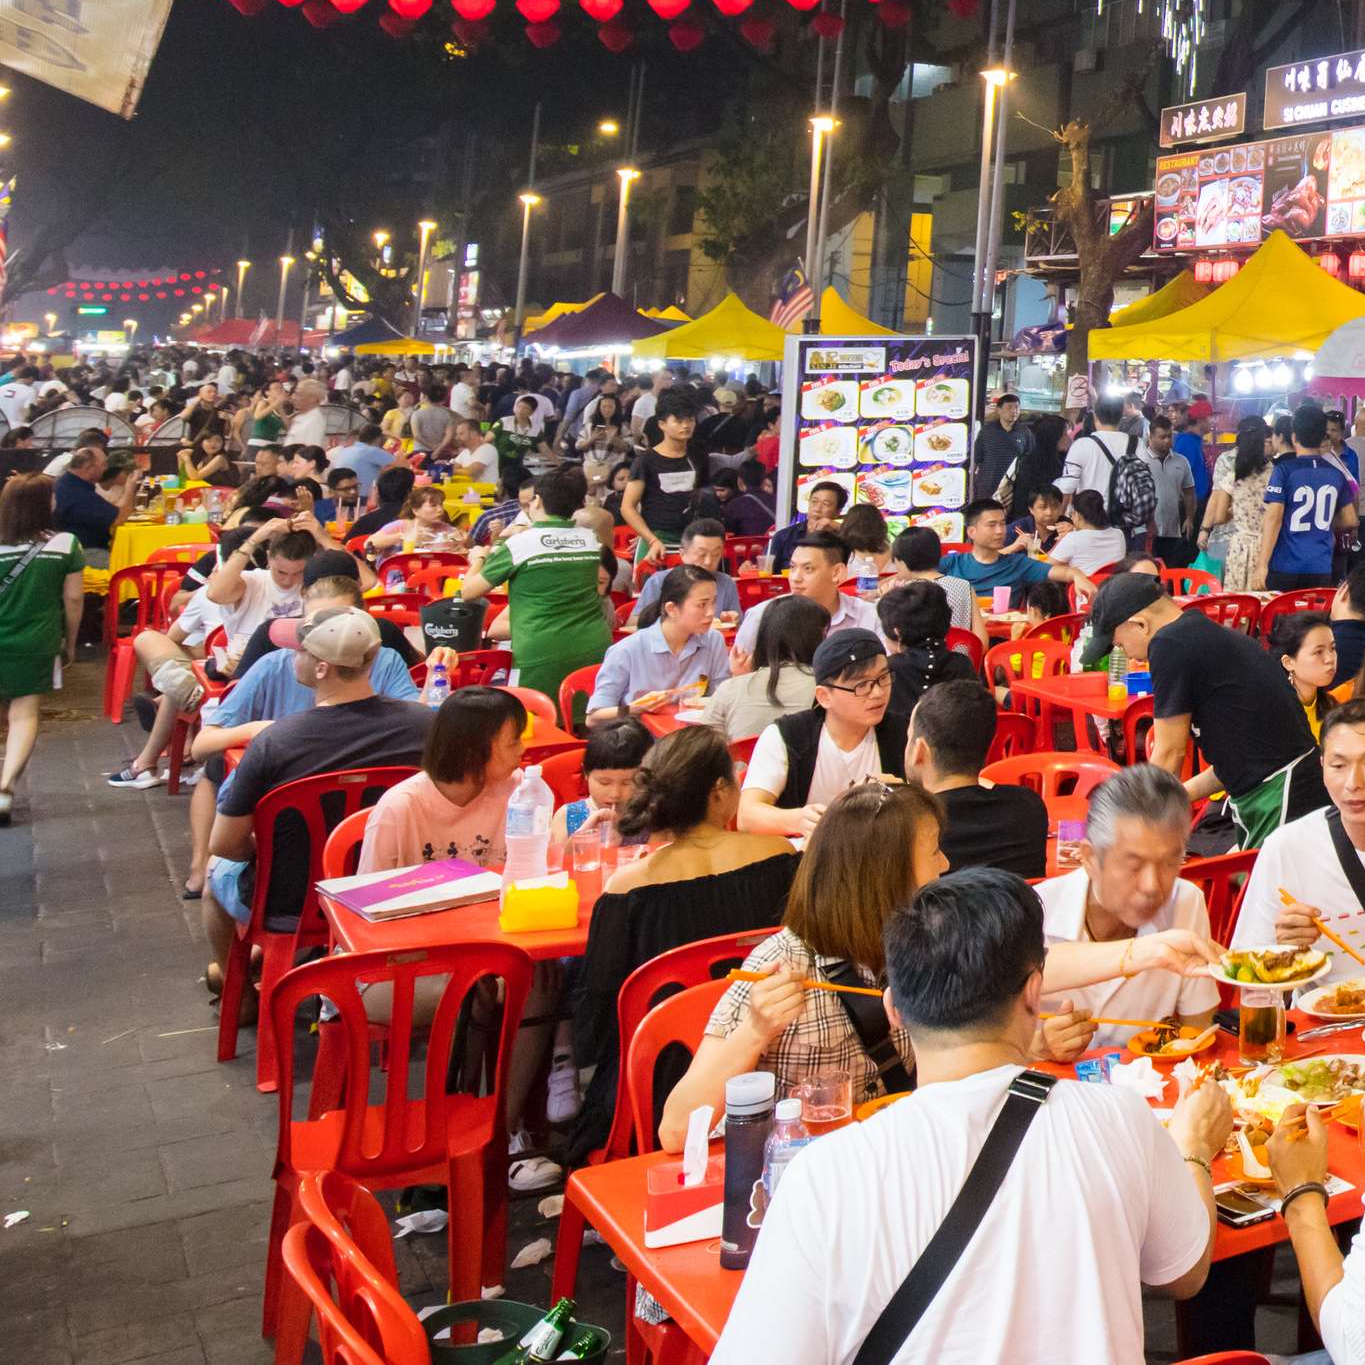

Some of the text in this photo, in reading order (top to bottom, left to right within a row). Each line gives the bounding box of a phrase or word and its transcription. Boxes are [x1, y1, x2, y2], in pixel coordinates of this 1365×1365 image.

[889, 350, 970, 374] Today's Special
[1289, 484, 1338, 533] 20
[540, 533, 586, 550] Carlsberg
[424, 623, 459, 638] Carlsberg
